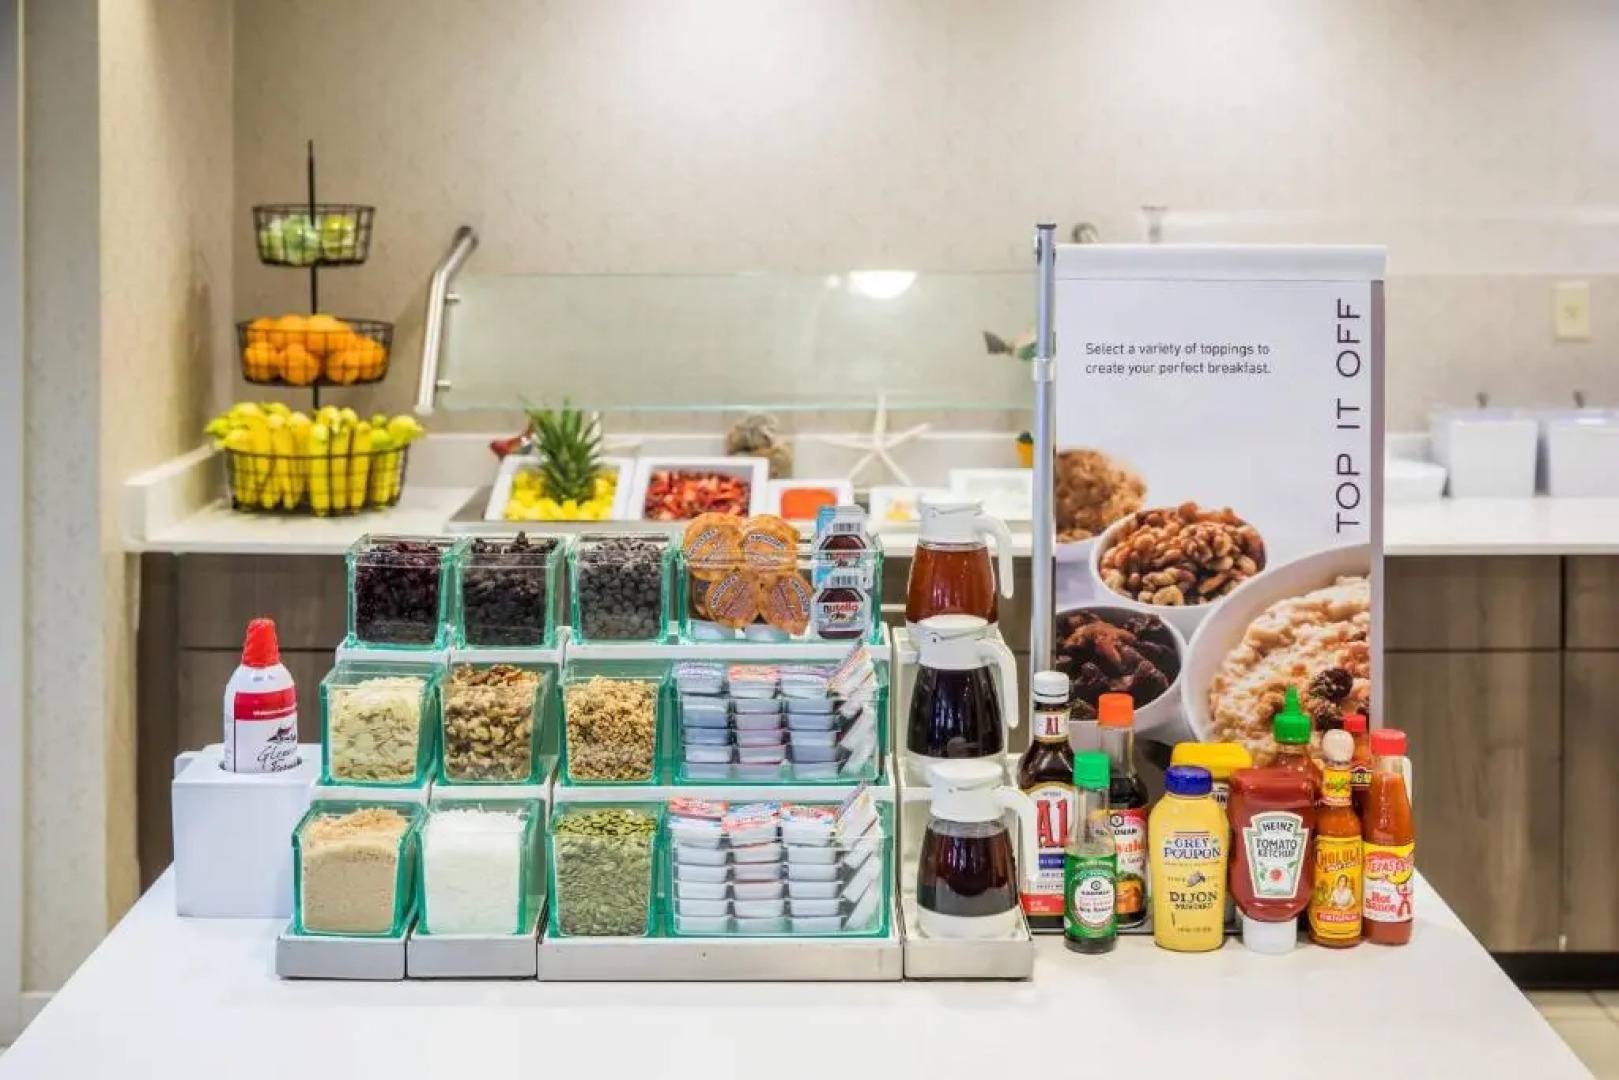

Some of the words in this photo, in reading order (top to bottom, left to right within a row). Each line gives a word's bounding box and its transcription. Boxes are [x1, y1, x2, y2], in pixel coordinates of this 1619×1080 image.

[1336, 298, 1360, 377] OFF
[1085, 342, 1124, 355] Select
[1128, 345, 1136, 355] a
[1138, 342, 1181, 357] variety
[1185, 342, 1197, 355] of
[1200, 342, 1255, 358] toppings
[1257, 343, 1270, 355] to
[1085, 362, 1125, 374] create
[1128, 364, 1156, 376] your
[1159, 361, 1204, 376] perfect
[1207, 361, 1272, 374] breakfast.
[1337, 398, 1360, 429] IT
[1336, 453, 1360, 533] TOP
[823, 601, 860, 613] nutella
[1262, 821, 1294, 832] HEINZ
[1174, 837, 1209, 848] GREY
[1256, 838, 1298, 850] TOMATO
[1163, 847, 1221, 859] POUPON
[1258, 849, 1296, 858] KETCHUP
[1169, 891, 1218, 902] DIJON
[1371, 891, 1392, 904] Hot
